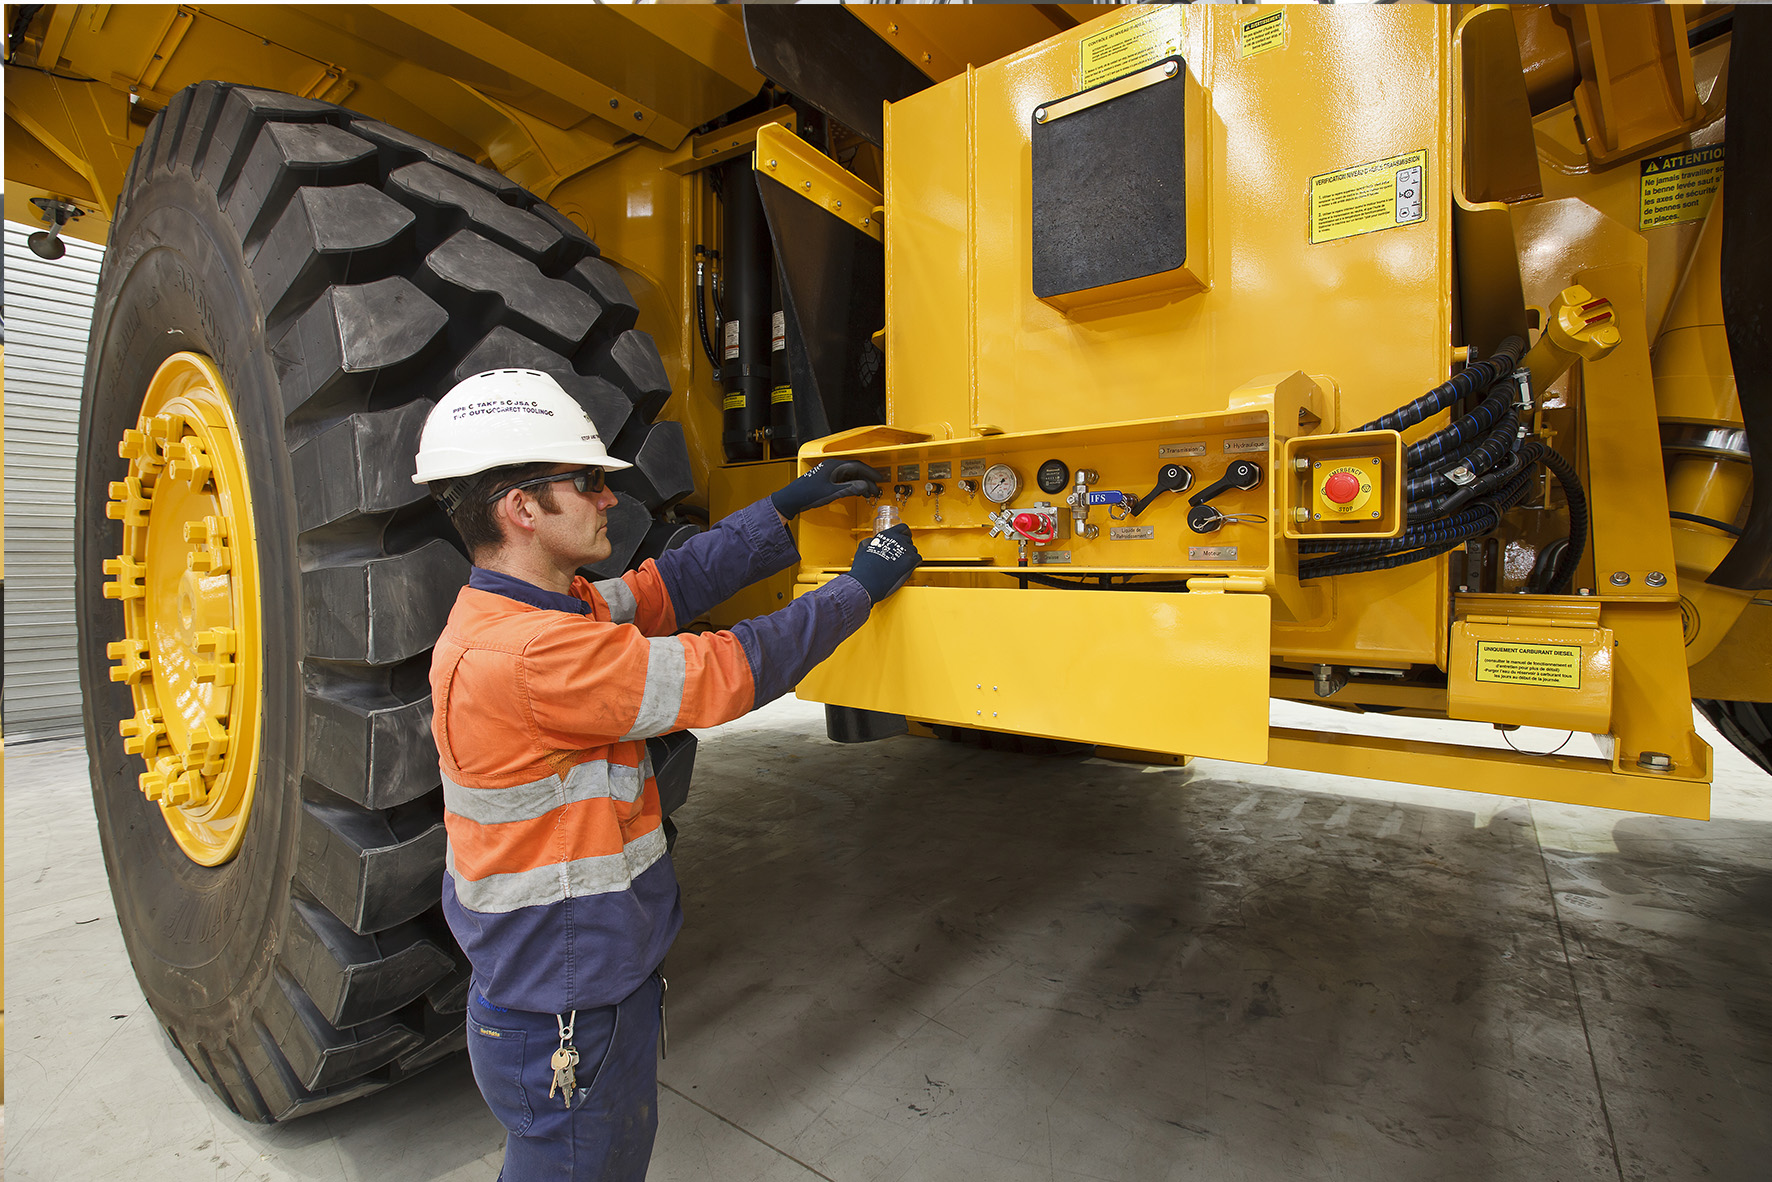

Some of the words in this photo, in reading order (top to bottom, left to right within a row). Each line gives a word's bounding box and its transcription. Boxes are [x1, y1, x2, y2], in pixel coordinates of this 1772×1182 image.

[1663, 147, 1725, 170] ATTENTIO
[1315, 174, 1346, 186] VERIFICATION
[1656, 174, 1680, 186] jamais
[1682, 167, 1713, 179] travailler
[1653, 184, 1675, 194] benne
[1677, 180, 1696, 189] levée
[1698, 176, 1714, 186] sauf
[1657, 195, 1673, 203] axes
[1655, 203, 1681, 213] bennes
[1683, 200, 1699, 208] sont
[1654, 214, 1680, 224] places.
[1329, 467, 1362, 477] EMERGENCY
[1091, 494, 1106, 503] IFS
